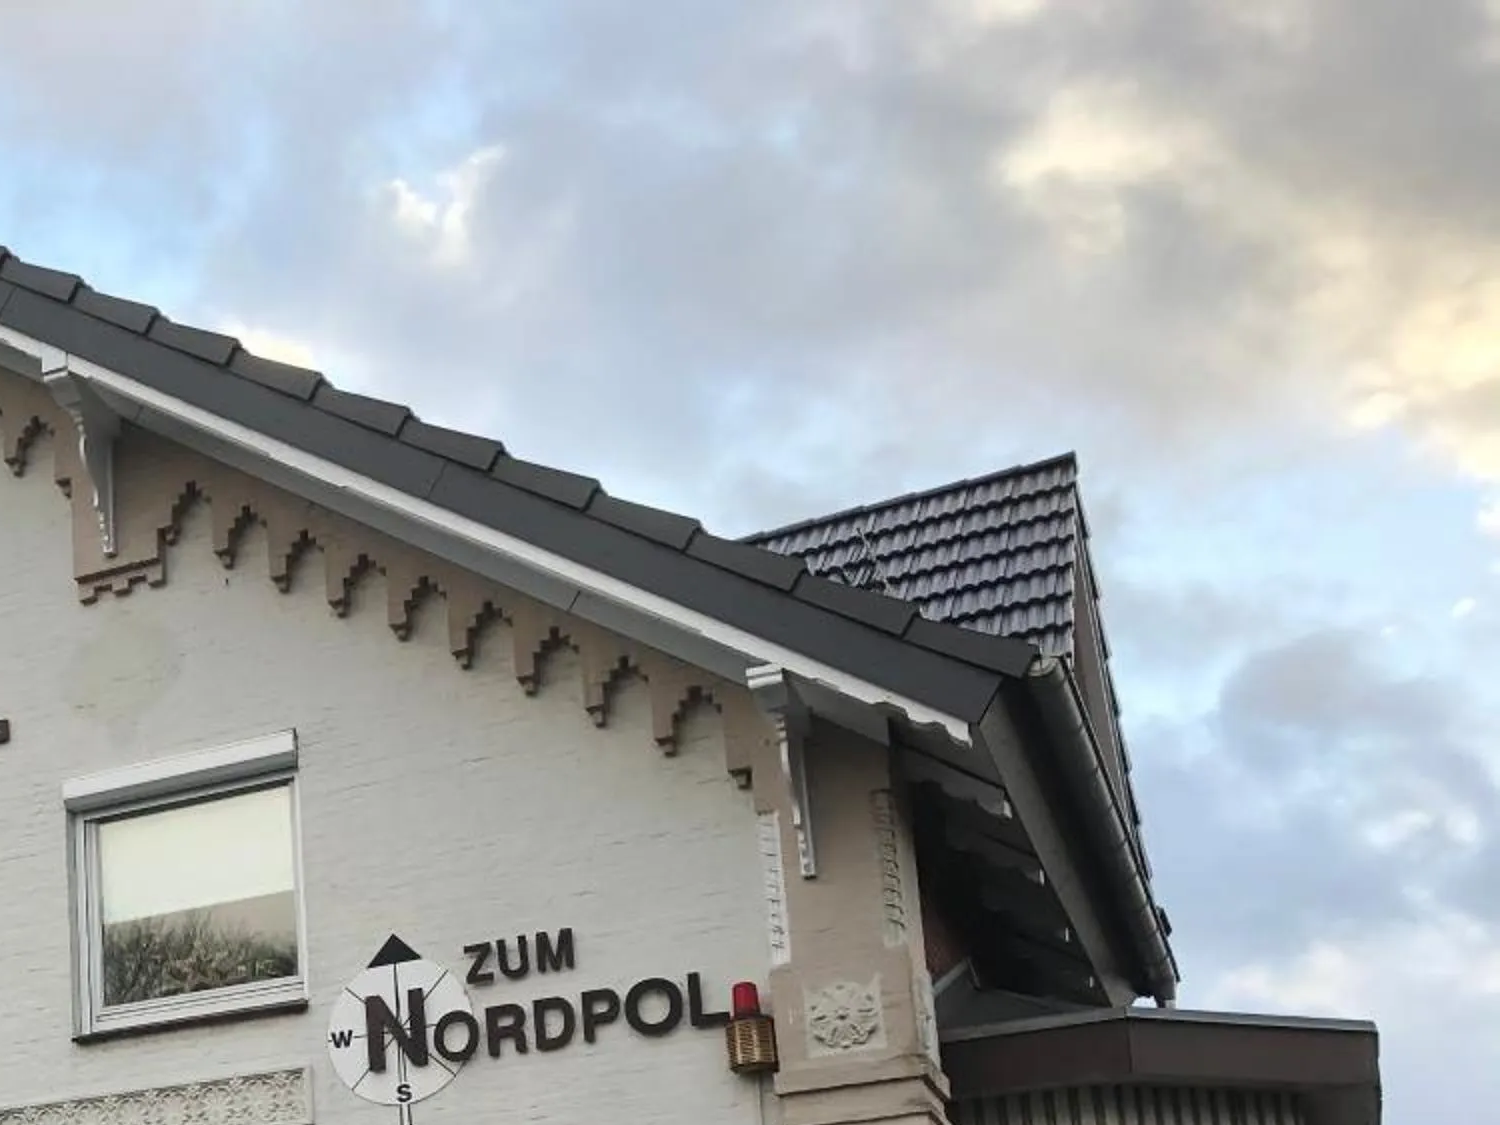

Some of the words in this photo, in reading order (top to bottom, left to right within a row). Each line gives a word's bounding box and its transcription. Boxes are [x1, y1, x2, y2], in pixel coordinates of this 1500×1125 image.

[463, 927, 575, 985] ZUM
[331, 1030, 353, 1048] W
[364, 971, 730, 1074] NORDPOL
[396, 1083, 413, 1102] S
